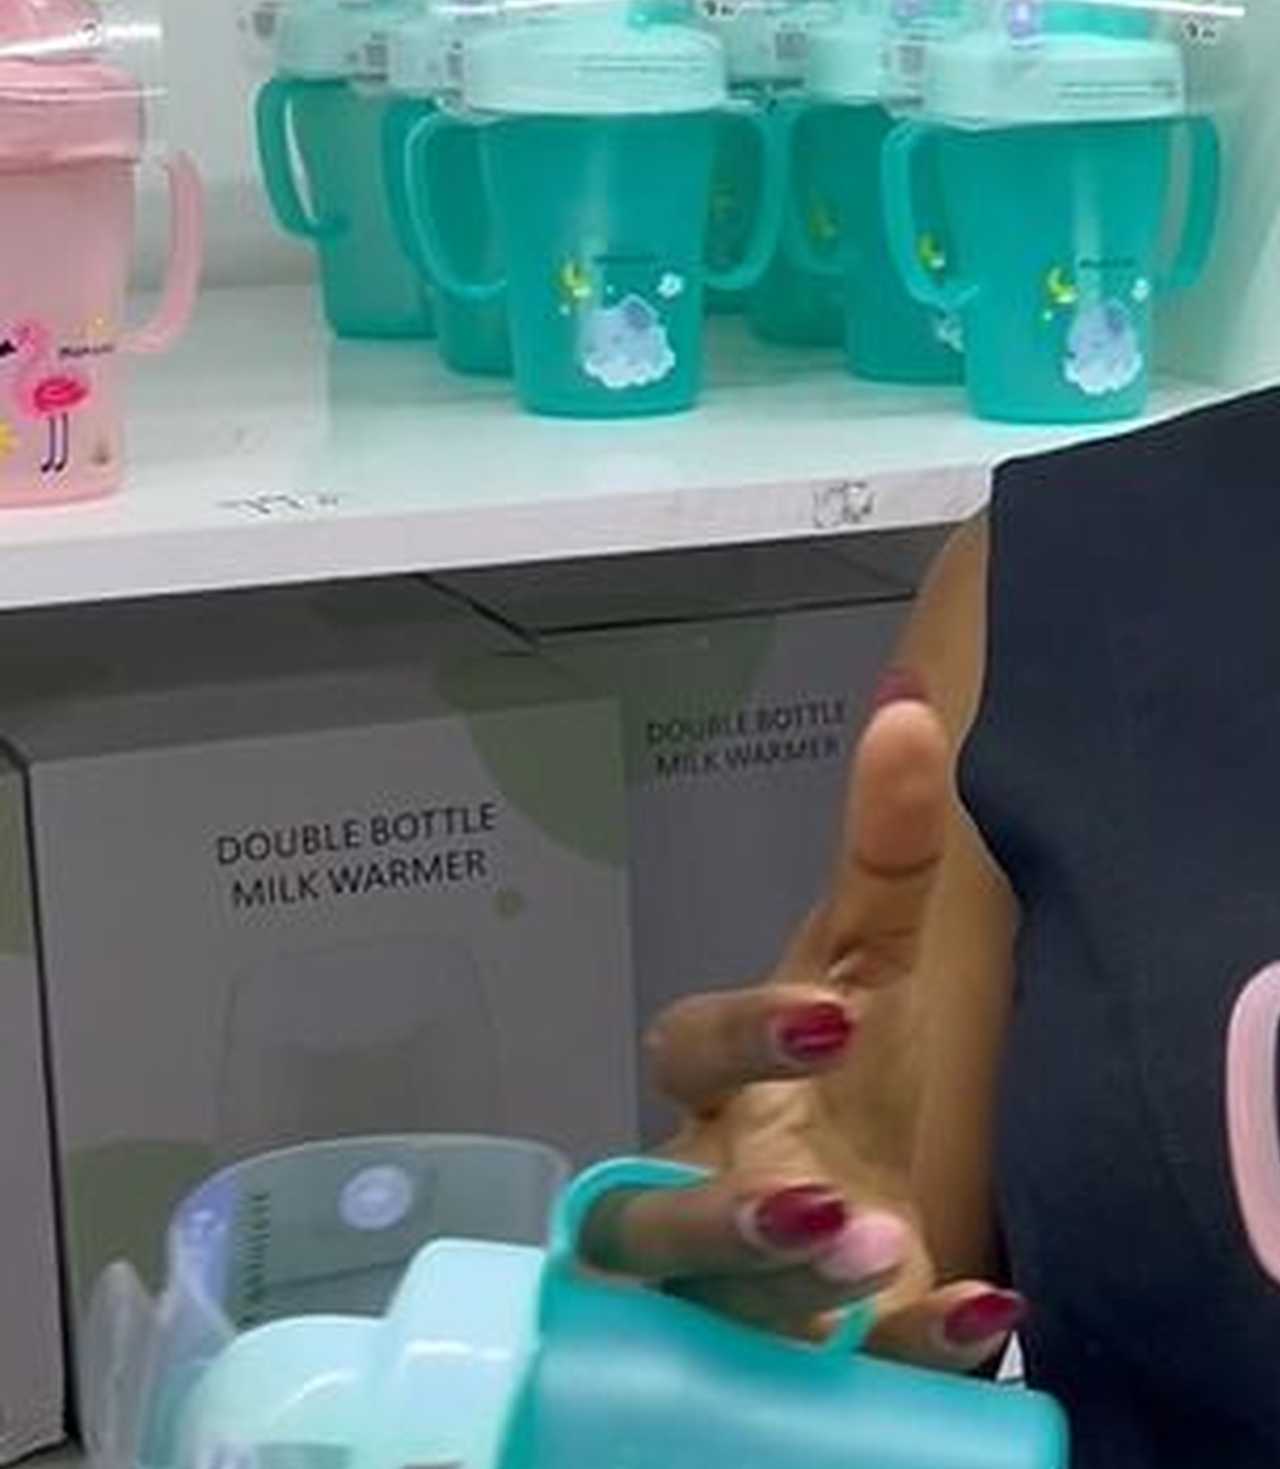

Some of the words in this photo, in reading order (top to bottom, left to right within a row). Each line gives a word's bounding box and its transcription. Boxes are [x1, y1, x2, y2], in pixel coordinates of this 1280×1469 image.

[648, 711, 746, 745] DOUBLE
[756, 698, 846, 732] BOTTLE
[724, 736, 841, 771] WARMER
[217, 819, 361, 865] DOUBLE
[369, 802, 498, 847] BOTTLE
[232, 868, 319, 907] MILK
[327, 848, 487, 894] WARMER
